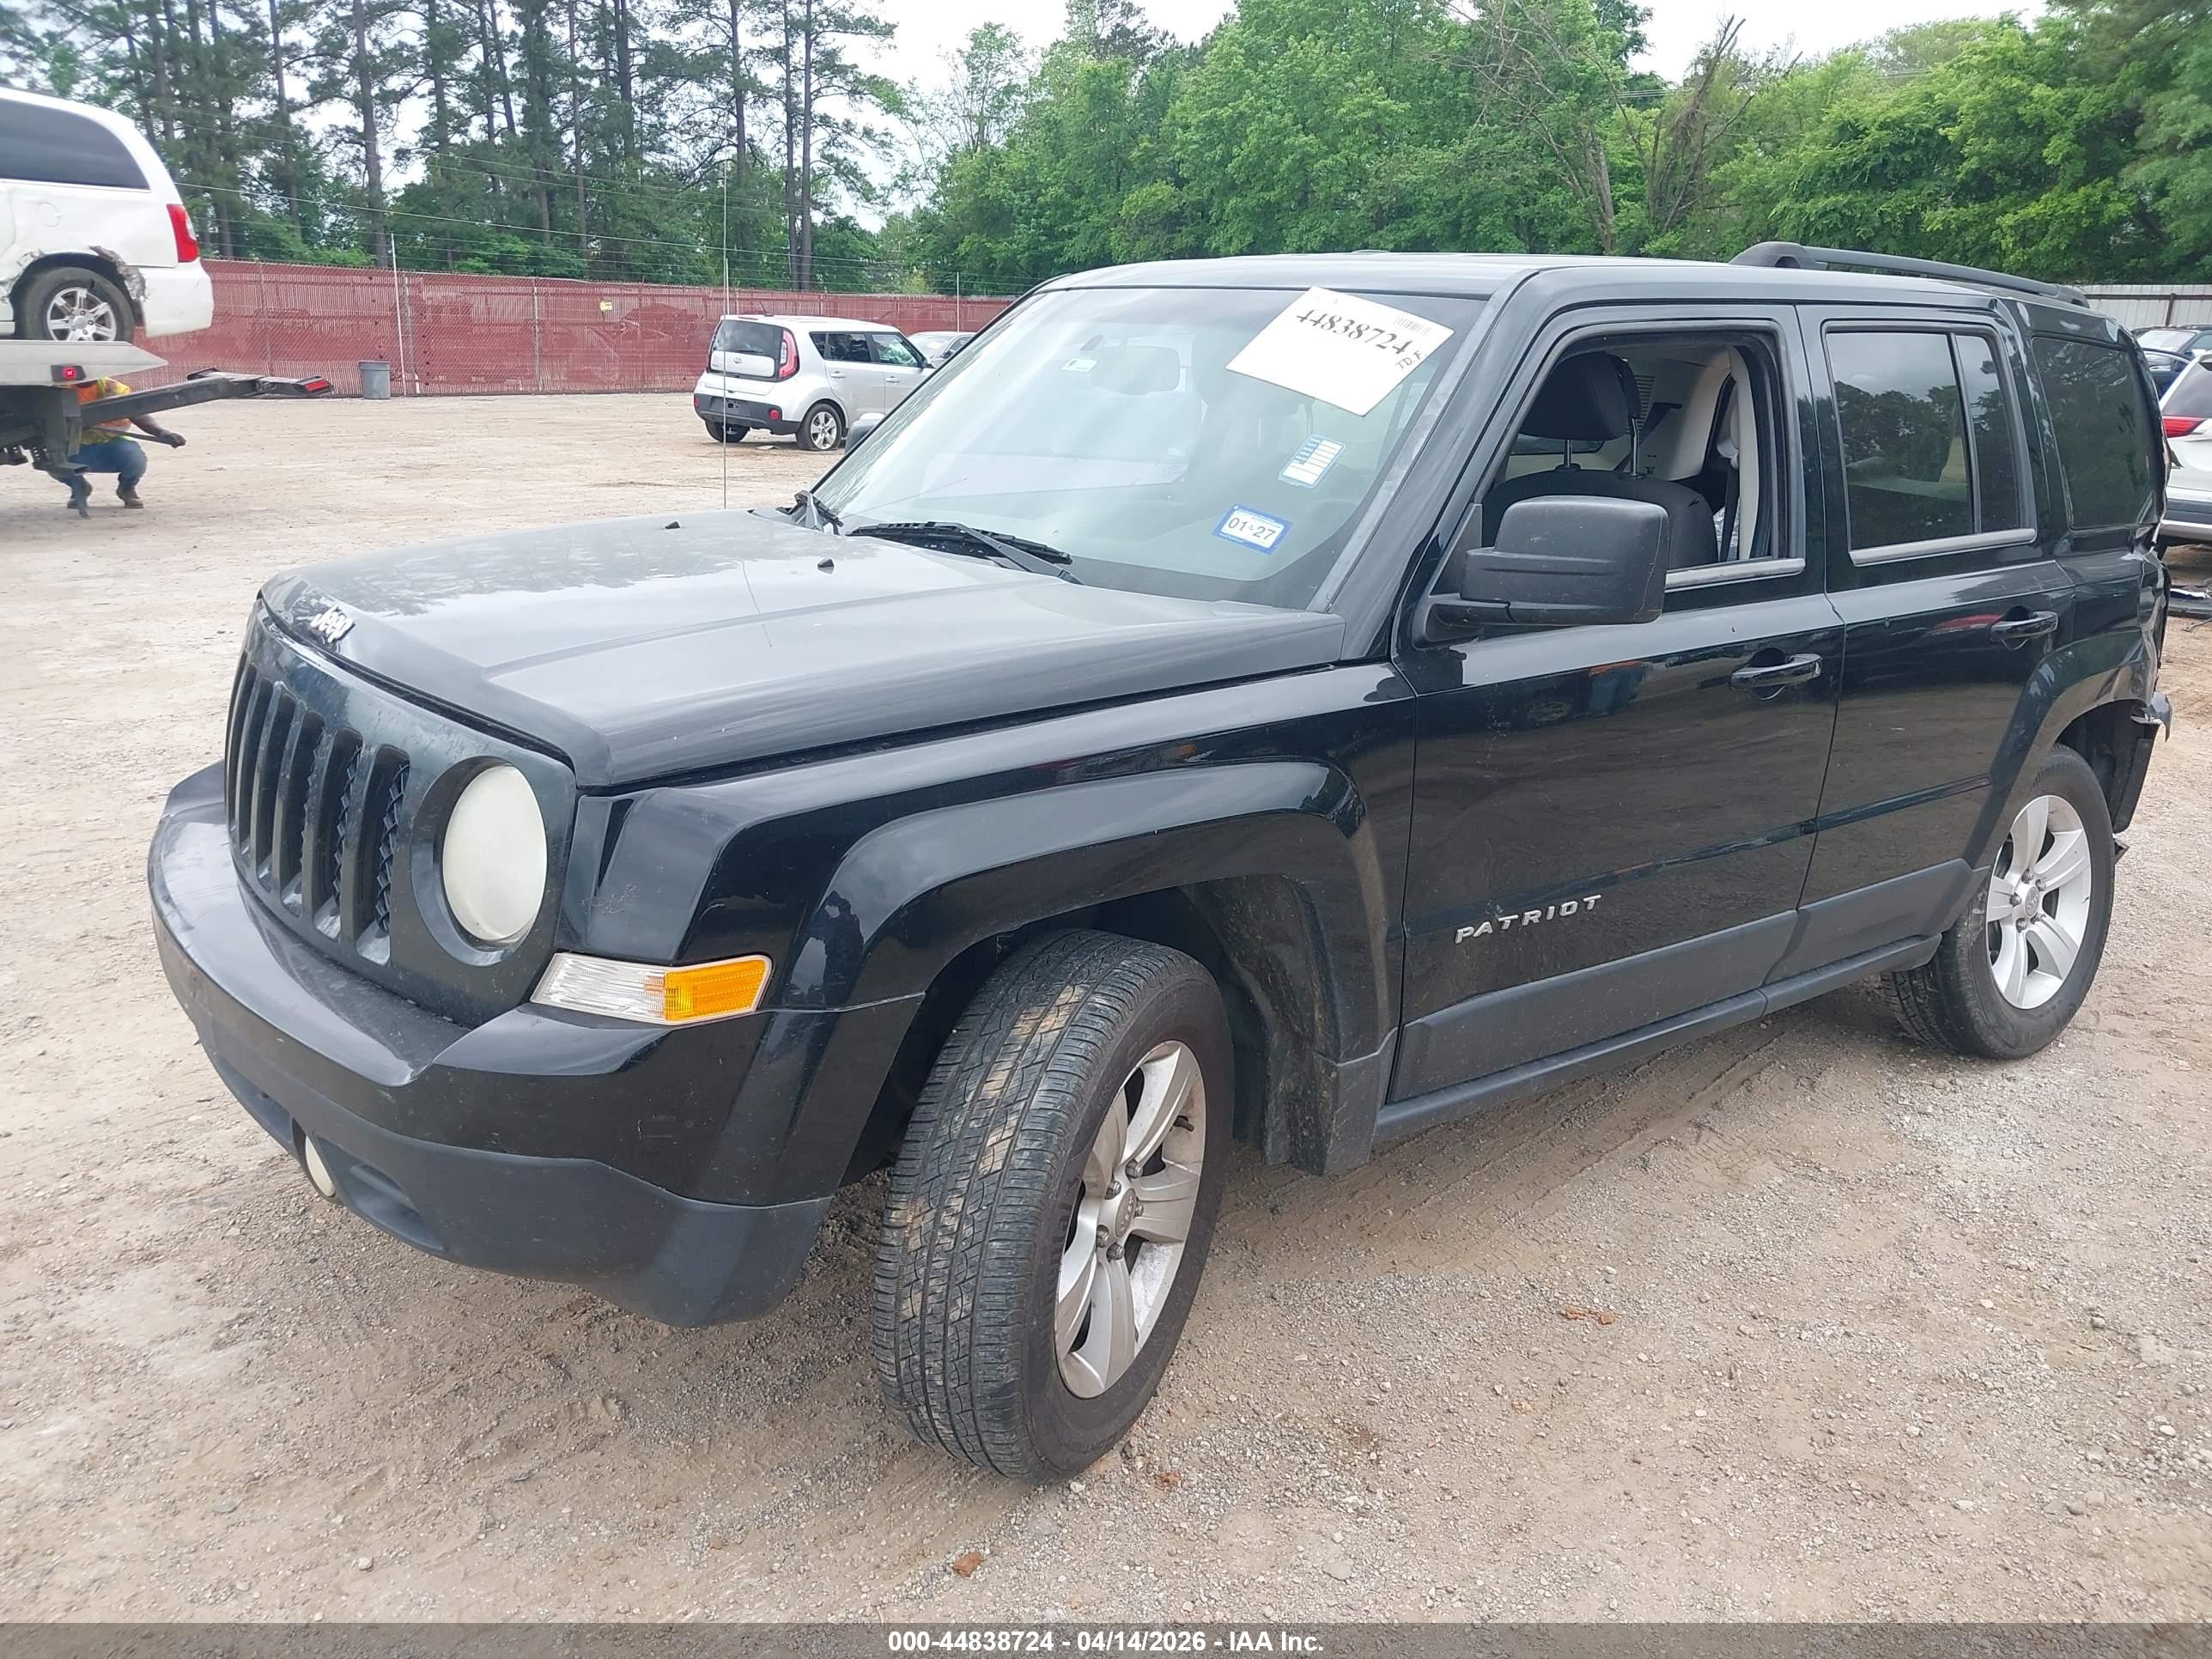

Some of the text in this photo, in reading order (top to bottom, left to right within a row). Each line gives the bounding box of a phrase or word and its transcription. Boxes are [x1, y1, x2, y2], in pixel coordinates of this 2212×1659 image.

[1296, 308, 1414, 355] 44838724
[310, 605, 355, 644] Jeep
[1454, 893, 1602, 945] PATRIOT
